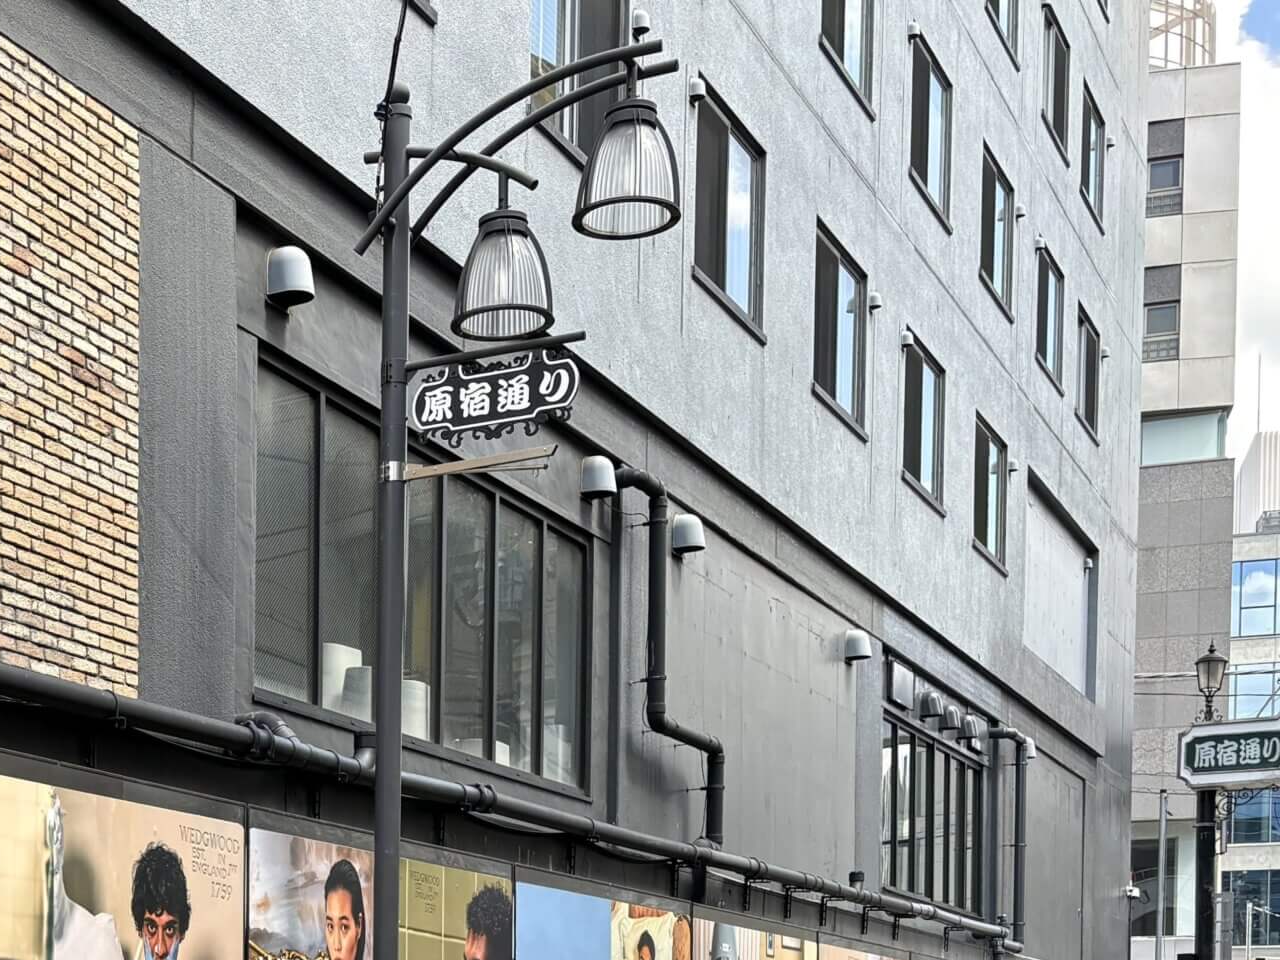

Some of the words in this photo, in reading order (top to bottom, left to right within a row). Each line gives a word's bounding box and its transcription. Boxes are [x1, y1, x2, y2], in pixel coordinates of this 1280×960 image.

[421, 369, 570, 423] 原宿通り
[1194, 737, 1280, 768] 原宿通り
[179, 824, 240, 855] WEDGWOOD
